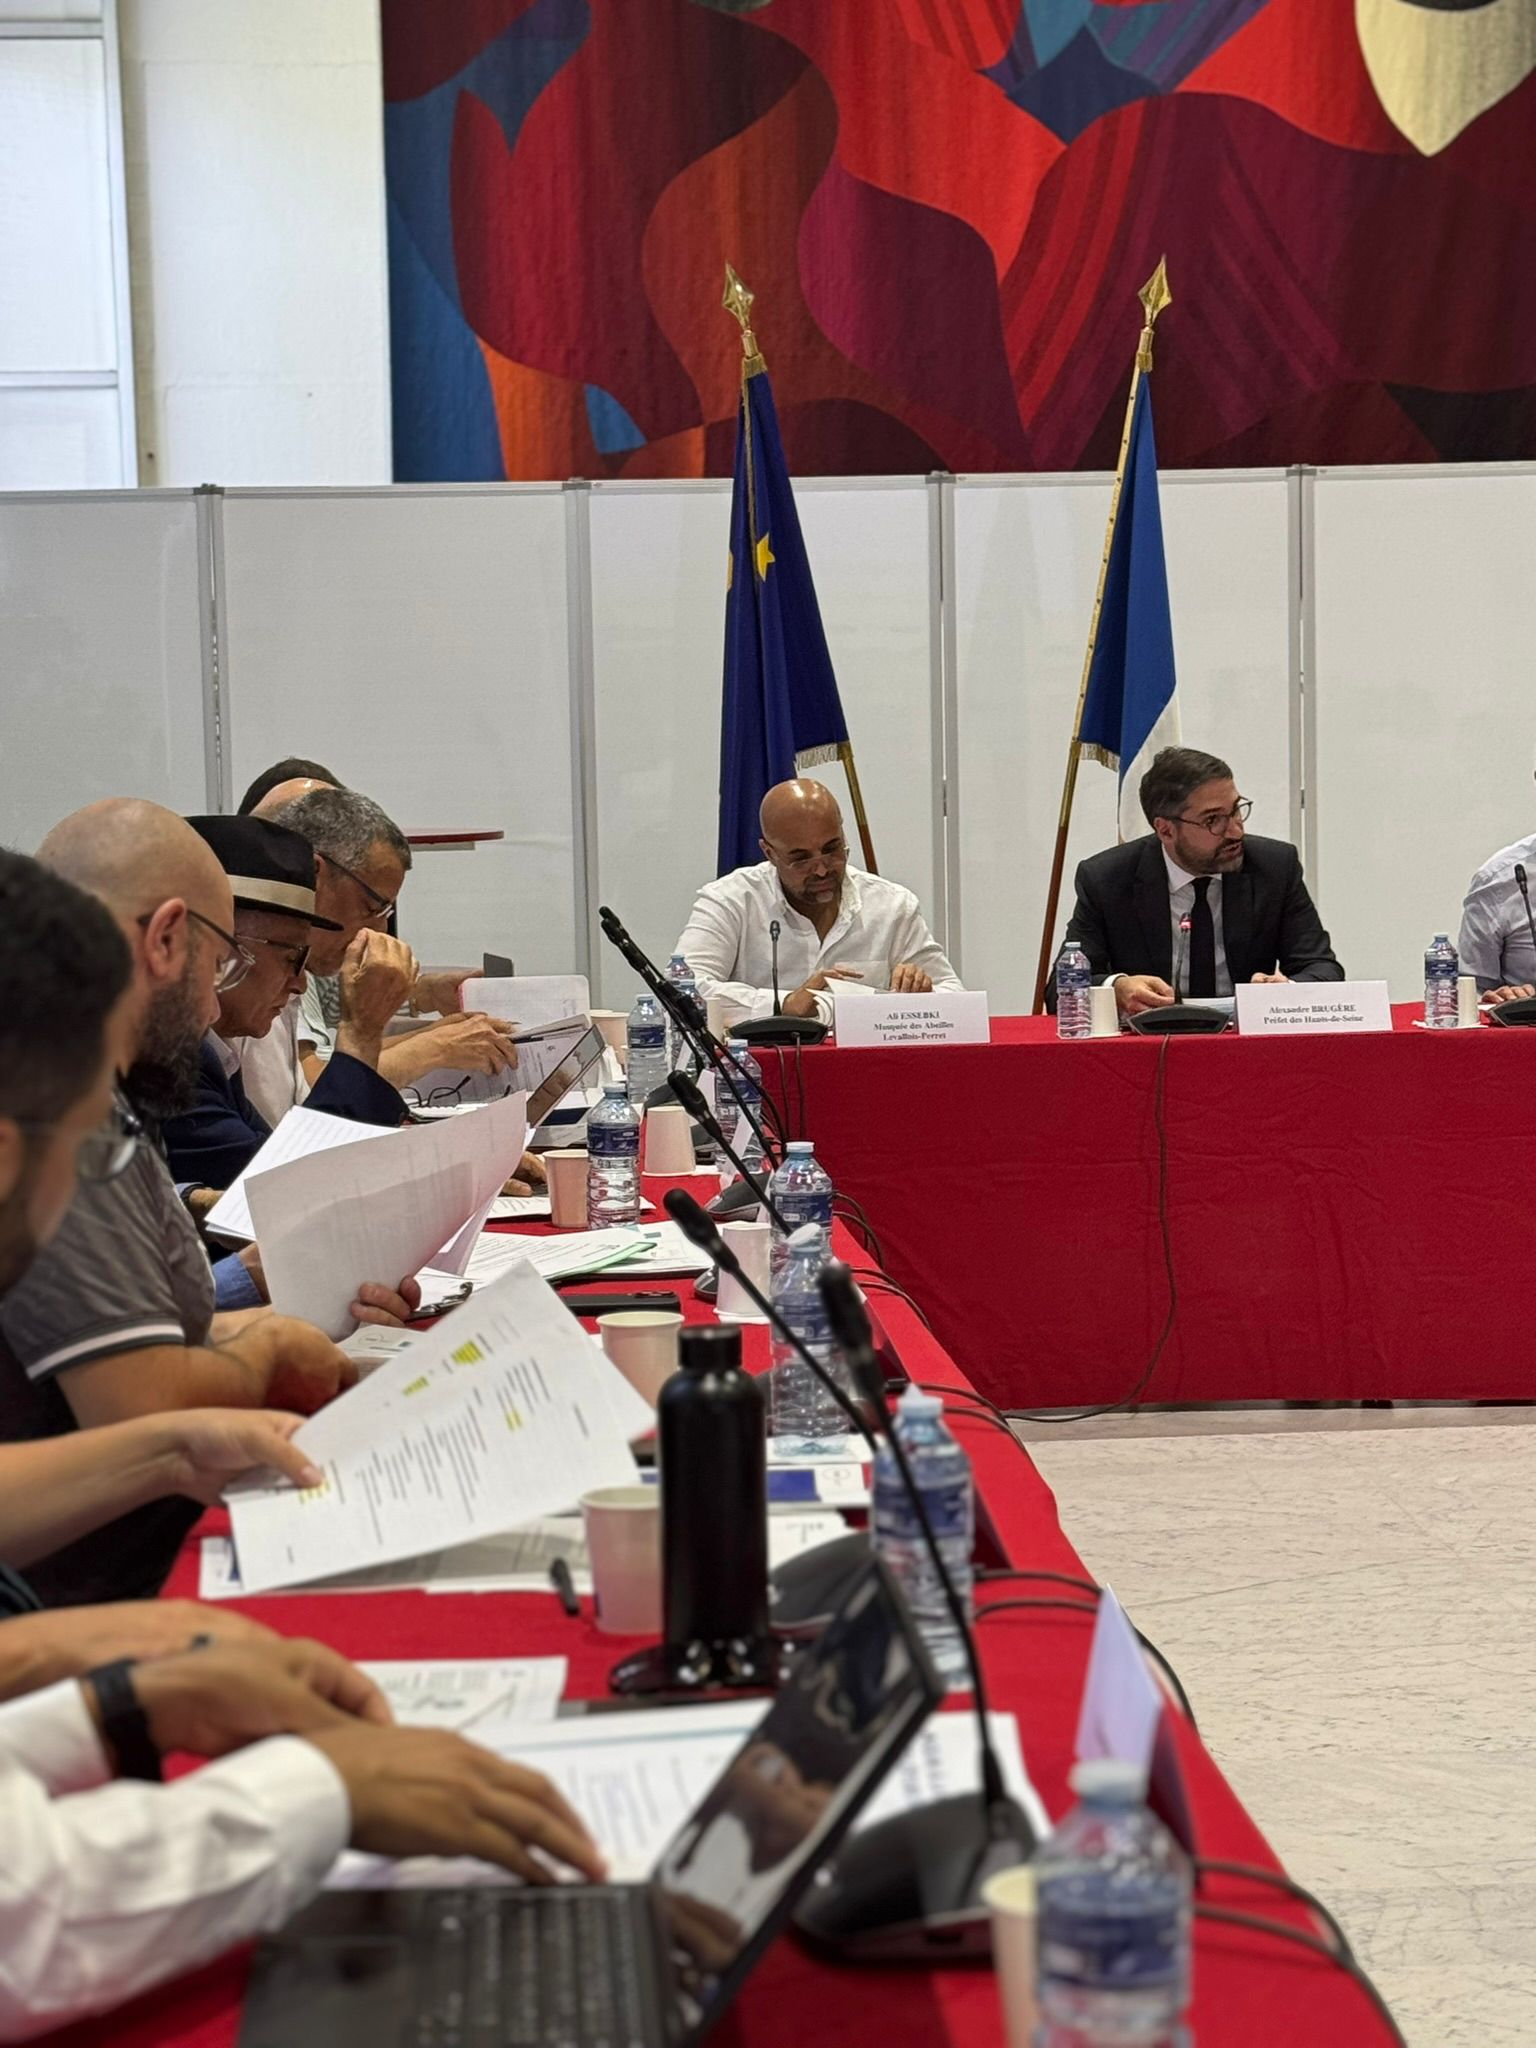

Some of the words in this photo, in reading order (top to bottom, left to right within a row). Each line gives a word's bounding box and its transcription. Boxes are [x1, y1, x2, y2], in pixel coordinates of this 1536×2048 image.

[1269, 1006, 1310, 1014] Alexandre
[1289, 1016, 1303, 1024] des
[909, 1022, 922, 1030] des
